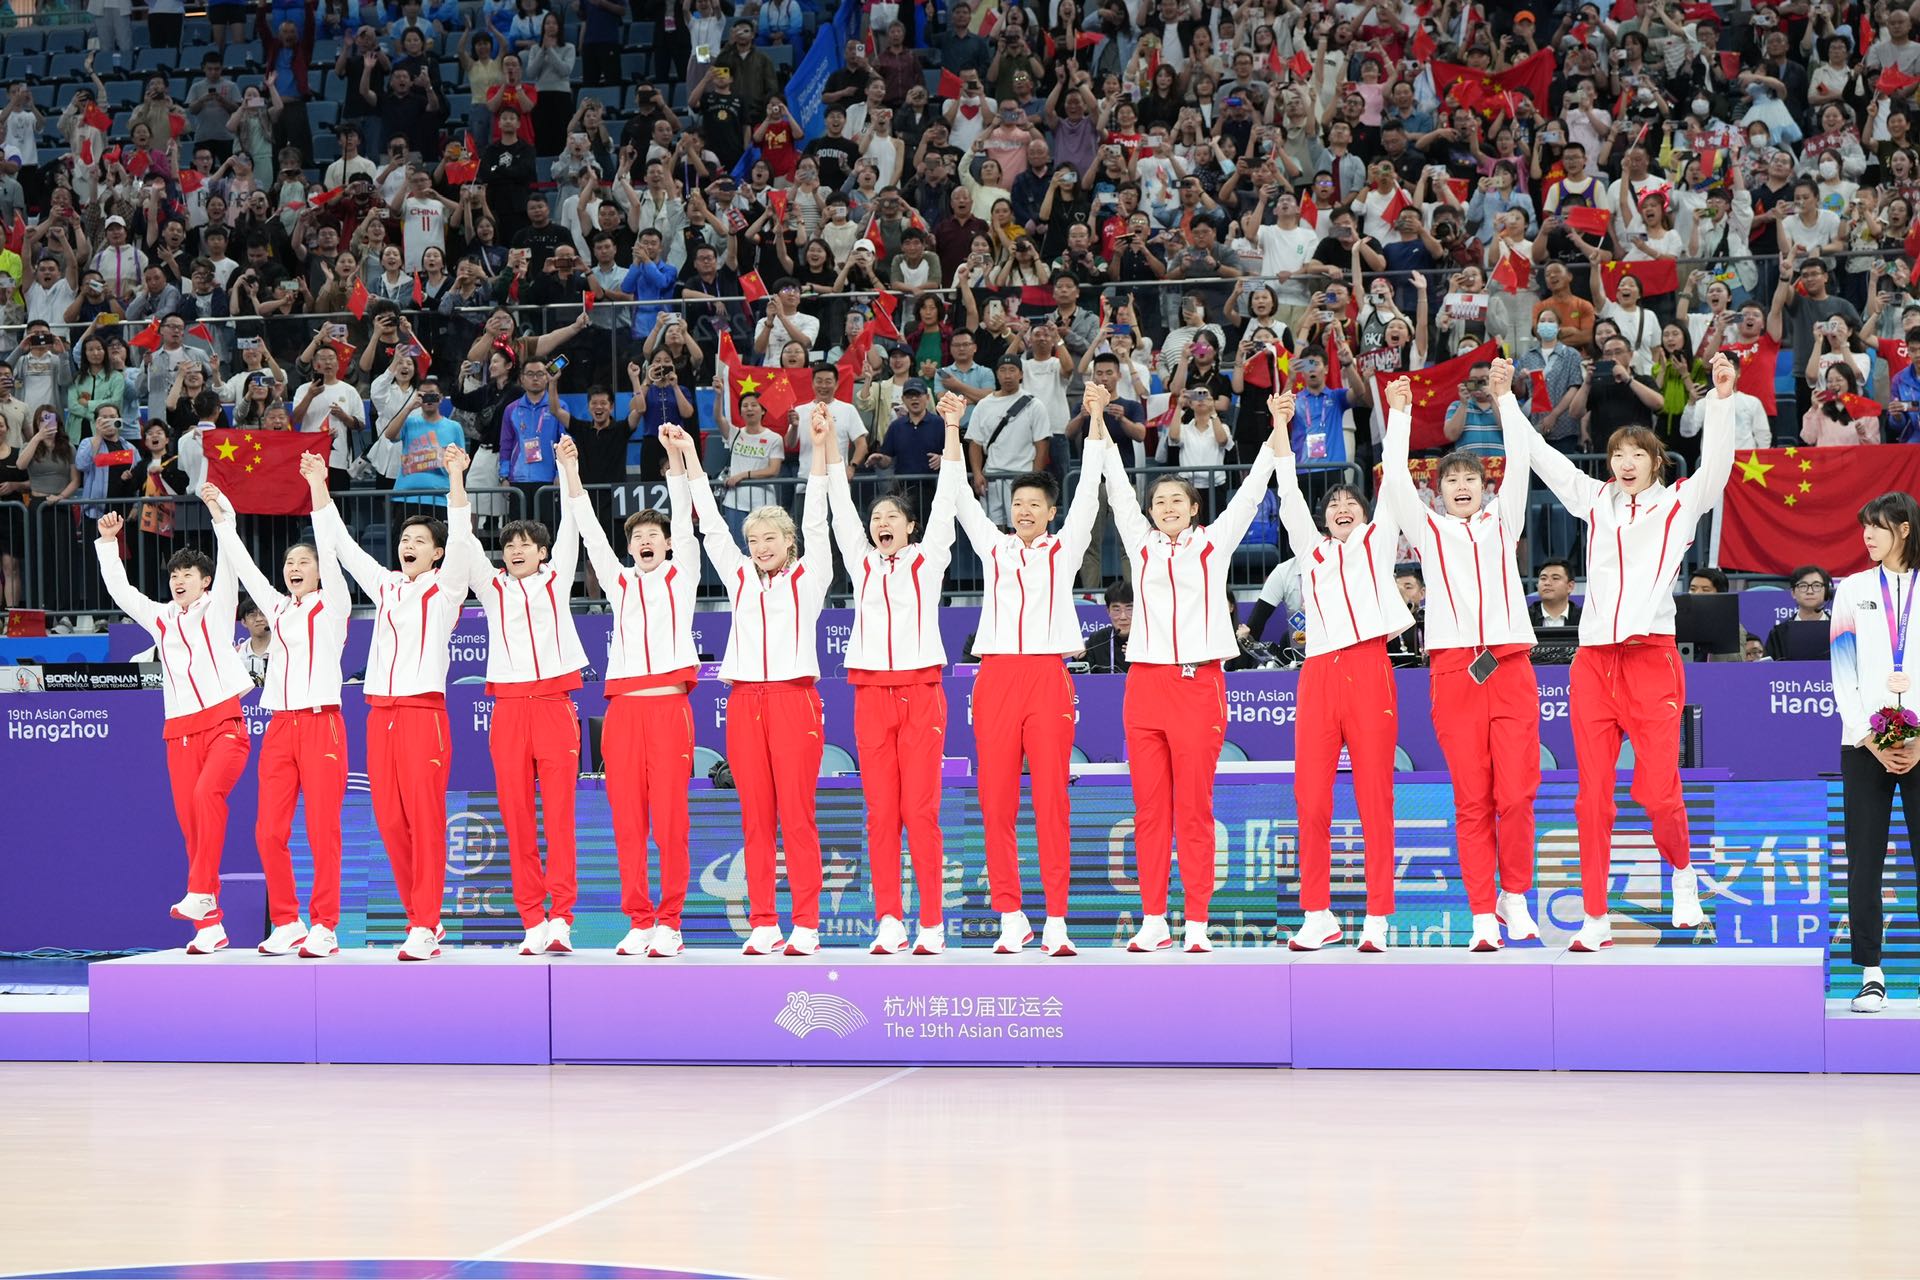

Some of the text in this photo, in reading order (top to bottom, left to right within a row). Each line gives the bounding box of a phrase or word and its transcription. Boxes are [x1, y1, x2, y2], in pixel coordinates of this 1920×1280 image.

[613, 484, 669, 517] 112
[450, 633, 486, 644] Games
[90, 674, 138, 684] BORNAN
[1537, 684, 1564, 697] sian
[1769, 680, 1834, 693] 19th Asia
[1226, 689, 1294, 702] 19th Asian
[241, 705, 263, 717] 9th
[1770, 694, 1840, 718] Hang
[7, 708, 109, 721] 19th Asian Games
[1226, 703, 1296, 726] Hangz
[8, 720, 109, 743] Hangzhou
[818, 917, 880, 937] CHIN
[883, 996, 1064, 1018] 杭州第19届亚运会
[883, 1022, 1064, 1038] The 19th Asian Games
